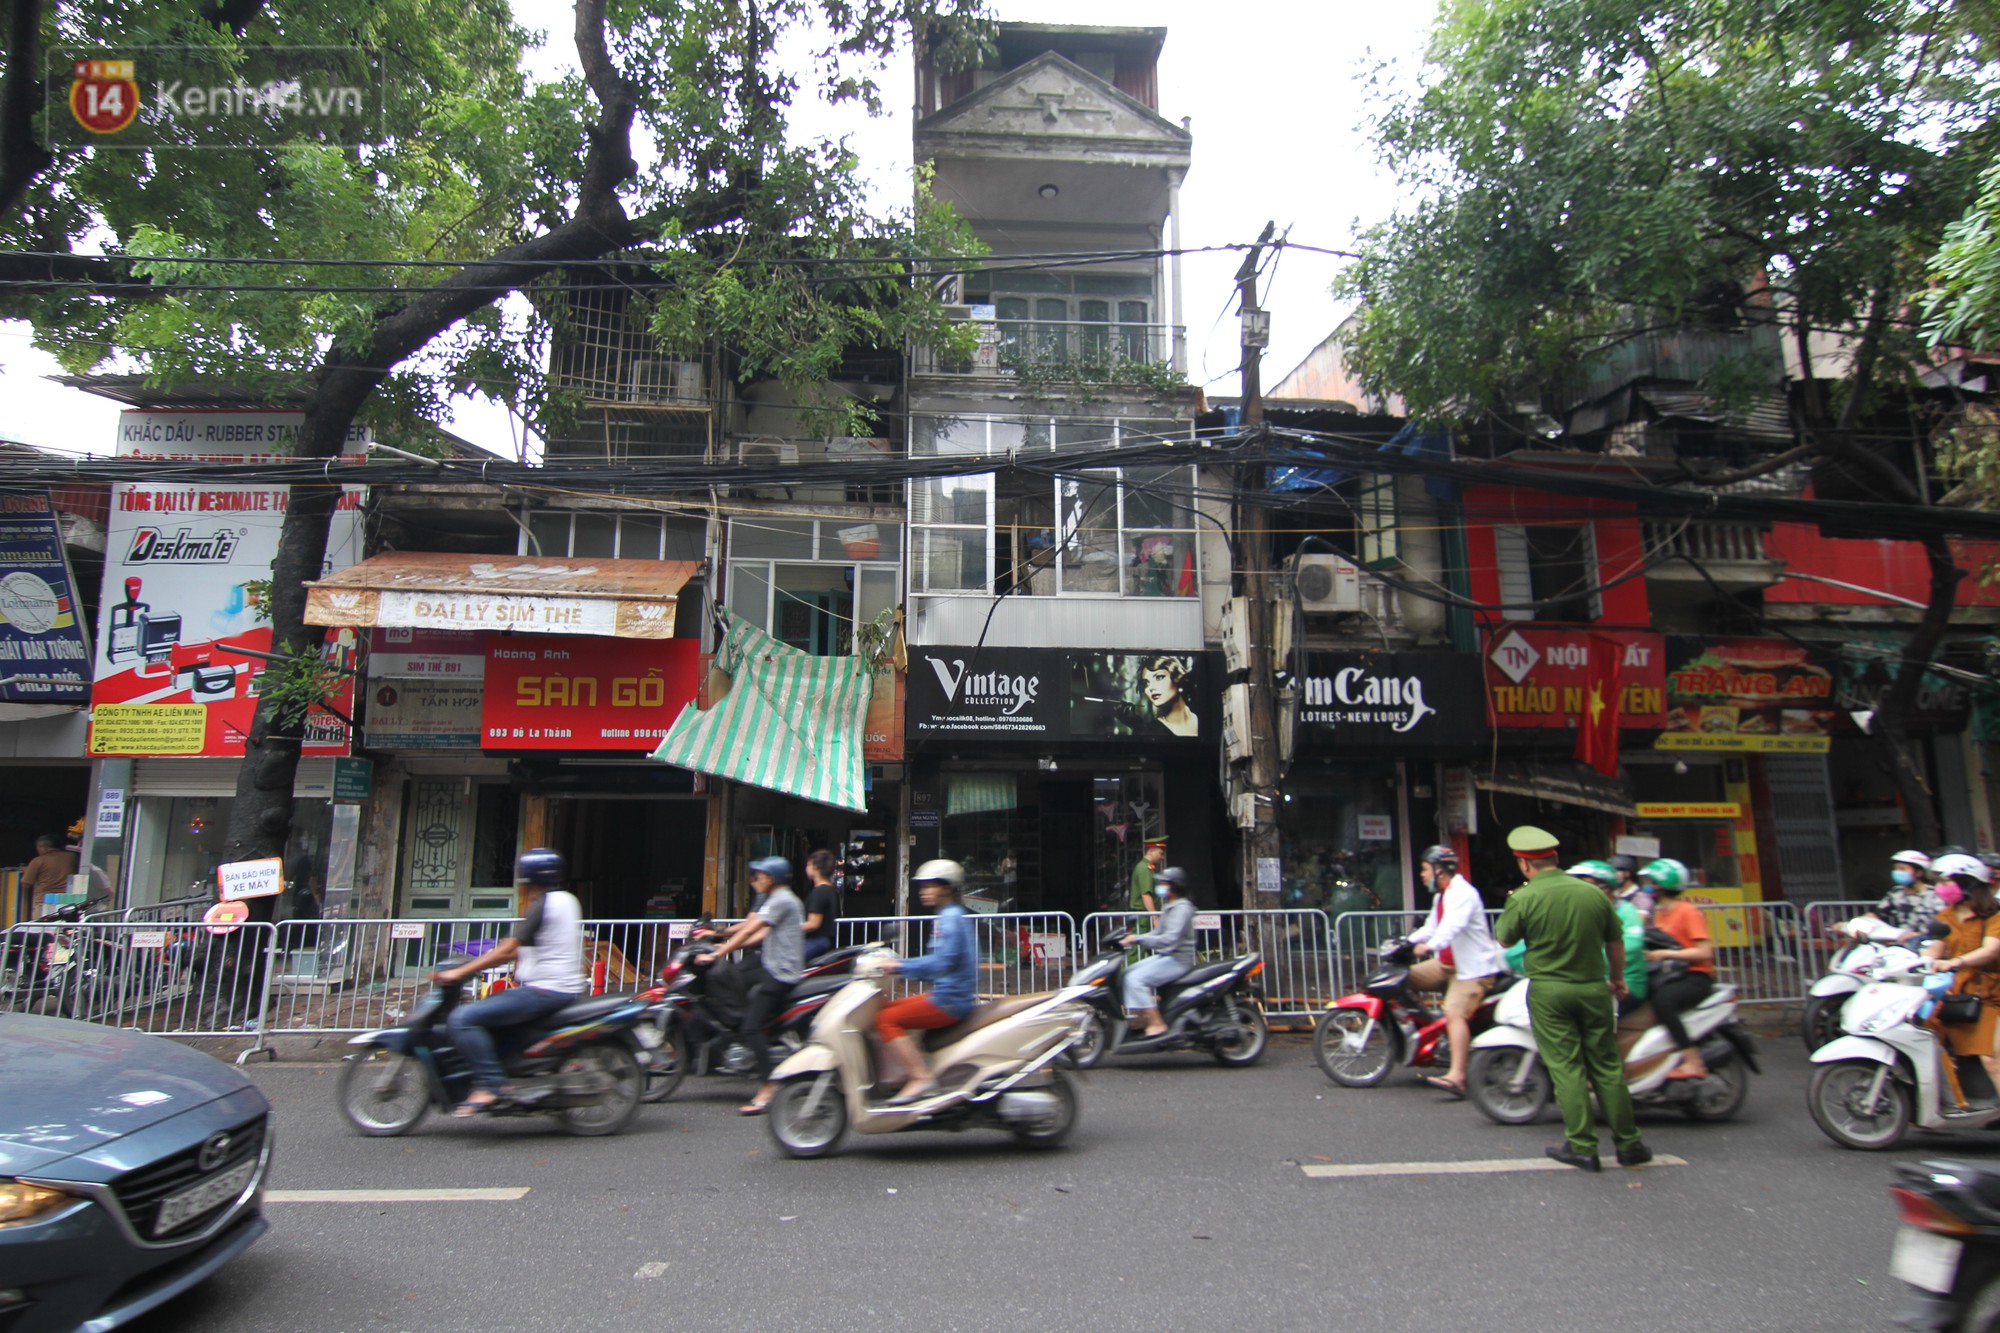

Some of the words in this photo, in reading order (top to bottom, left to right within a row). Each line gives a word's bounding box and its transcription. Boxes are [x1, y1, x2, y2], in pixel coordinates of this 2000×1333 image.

[122, 417, 162, 442] KHẮC
[165, 419, 195, 442] DẤU
[206, 426, 263, 443] RUBBER
[119, 484, 151, 512] TỔNG
[154, 491, 178, 515] ĐẠI
[179, 487, 196, 512] LÝ
[197, 490, 270, 511] DESKMATE
[127, 529, 234, 562] Deskmate
[415, 601, 456, 623] ĐẠI
[464, 599, 490, 621] LÝ
[496, 605, 535, 622] SIM
[544, 601, 583, 625] THẺ
[407, 661, 425, 672] SIM
[427, 659, 443, 672] THẺ
[445, 662, 461, 673] 891
[543, 649, 570, 660] Anh
[1547, 643, 1588, 670] NỘI
[516, 671, 598, 707] SÀN
[611, 666, 665, 707] GỖ
[924, 653, 1040, 716] Vintage
[1493, 676, 1557, 714] THẢO
[1785, 675, 1833, 698] AN
[121, 708, 130, 717] TY
[131, 708, 152, 717] TNHH
[183, 708, 203, 717] MINH
[964, 697, 1015, 705] COLLECTION
[1300, 711, 1371, 723] LOTHES-NEW
[1373, 711, 1408, 722] LOOKS
[529, 728, 540, 738] La
[601, 728, 630, 738] Hotline
[105, 791, 120, 800] 889
[233, 883, 246, 893] XE
